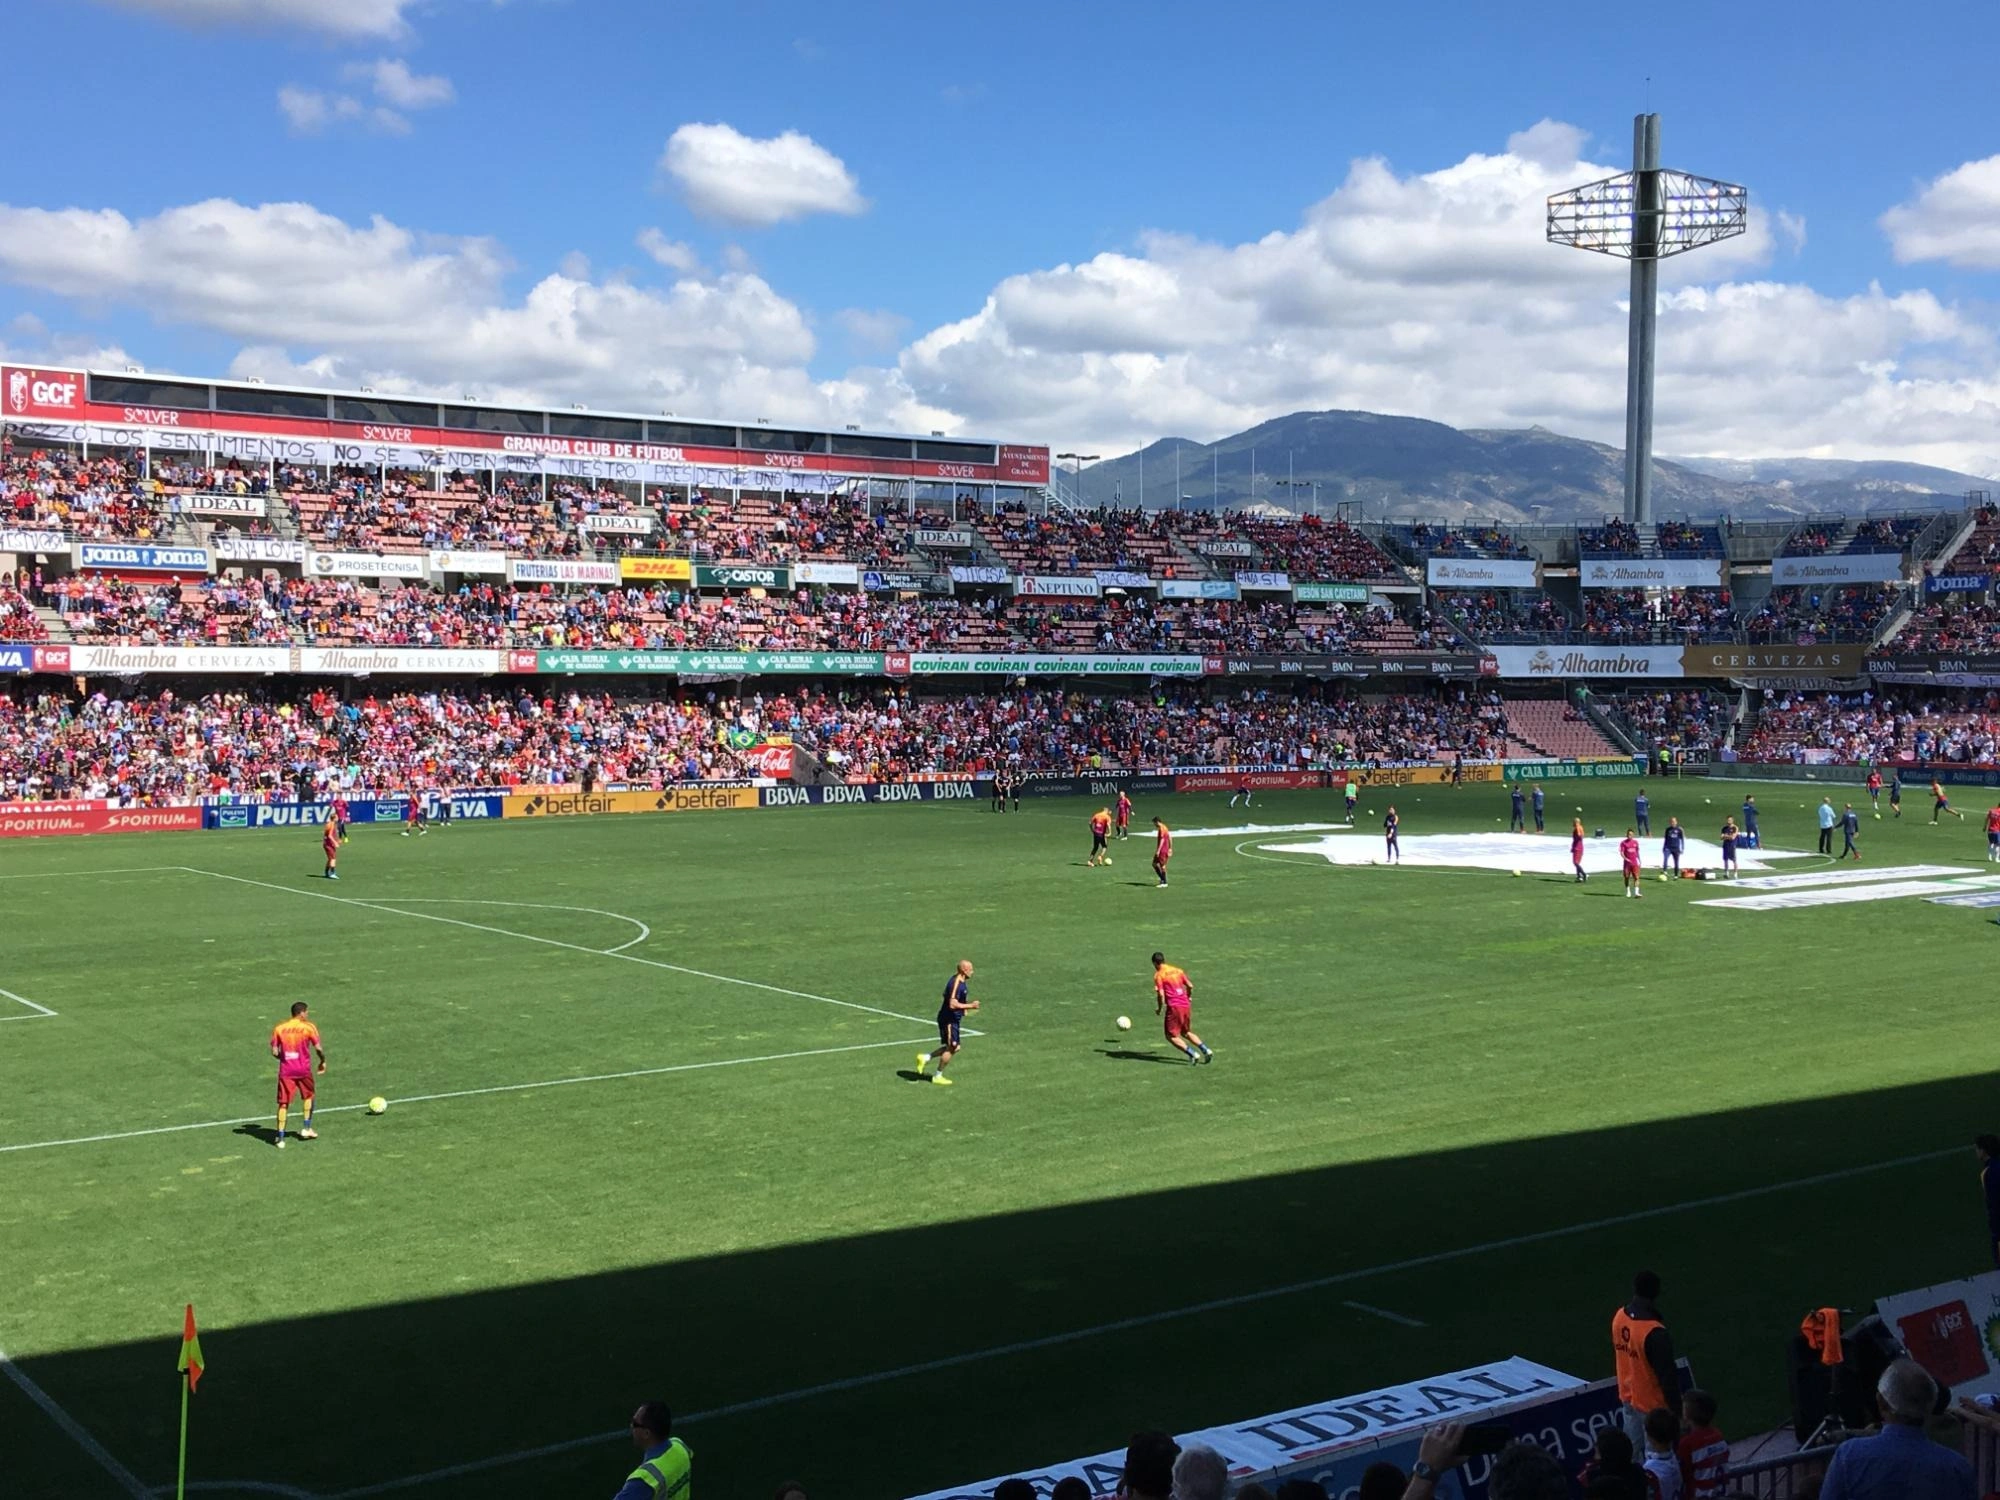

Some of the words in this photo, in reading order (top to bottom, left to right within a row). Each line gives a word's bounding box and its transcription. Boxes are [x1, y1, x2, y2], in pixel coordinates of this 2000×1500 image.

[32, 381, 77, 403] GCF
[124, 407, 180, 425] SOLVER
[363, 426, 412, 442] SOLVER
[101, 429, 144, 447] LOS
[158, 431, 316, 458] SENTIMIENTOS
[334, 444, 362, 461] NO
[374, 447, 401, 462] SE
[559, 459, 637, 479] NUESTRO
[503, 436, 570, 454] GRANADA
[573, 442, 610, 457] CLUB
[614, 445, 632, 458] DE
[765, 453, 805, 467] SOLVER
[938, 463, 975, 477] SOLVER
[190, 496, 257, 512] IDEAL
[591, 516, 645, 530] IDEAL
[920, 530, 963, 542] IDEAL
[1206, 543, 1244, 553] IDEAL
[338, 560, 419, 573] PROSETECNISA
[516, 563, 558, 578] FRUTERIAS
[561, 566, 575, 578] LAS
[577, 567, 614, 580] MARINAS
[633, 562, 679, 575] DHL
[1451, 568, 1494, 580] Alhambra
[1611, 567, 1665, 580] Alhambra
[1801, 566, 1849, 577] Alhambra
[732, 569, 775, 583] CASTOR
[1036, 583, 1093, 595] NEPTUNO
[45, 652, 68, 664] GCF
[86, 648, 177, 668] Alhambra
[187, 656, 276, 667] CERVEZAS
[318, 650, 398, 669] Alhambra
[407, 656, 485, 668] CERVEZAS
[1557, 652, 1649, 675] Alhambra
[1713, 654, 1841, 666] CERVEZAS
[1868, 661, 1896, 672] BMN
[1939, 660, 1968, 671] BMN
[1228, 662, 1250, 672] BMN
[1281, 662, 1302, 672] BMN
[1332, 662, 1353, 672] BMN
[1382, 662, 1403, 672] BMN
[1431, 662, 1451, 672] BMN
[1374, 768, 1416, 784] betfair
[1460, 765, 1492, 781] etfair
[1521, 767, 1544, 777] CAJA
[1581, 765, 1594, 776] DE
[1595, 764, 1640, 776] GRANADA
[766, 787, 810, 806] BBVA
[823, 785, 866, 803] BBVA
[879, 783, 921, 800] BBVA
[934, 782, 975, 799] BBVA
[1091, 782, 1118, 795] BMN
[546, 793, 617, 814] betfair
[676, 789, 742, 809] betfair
[1239, 1371, 1554, 1452] IDEAL
